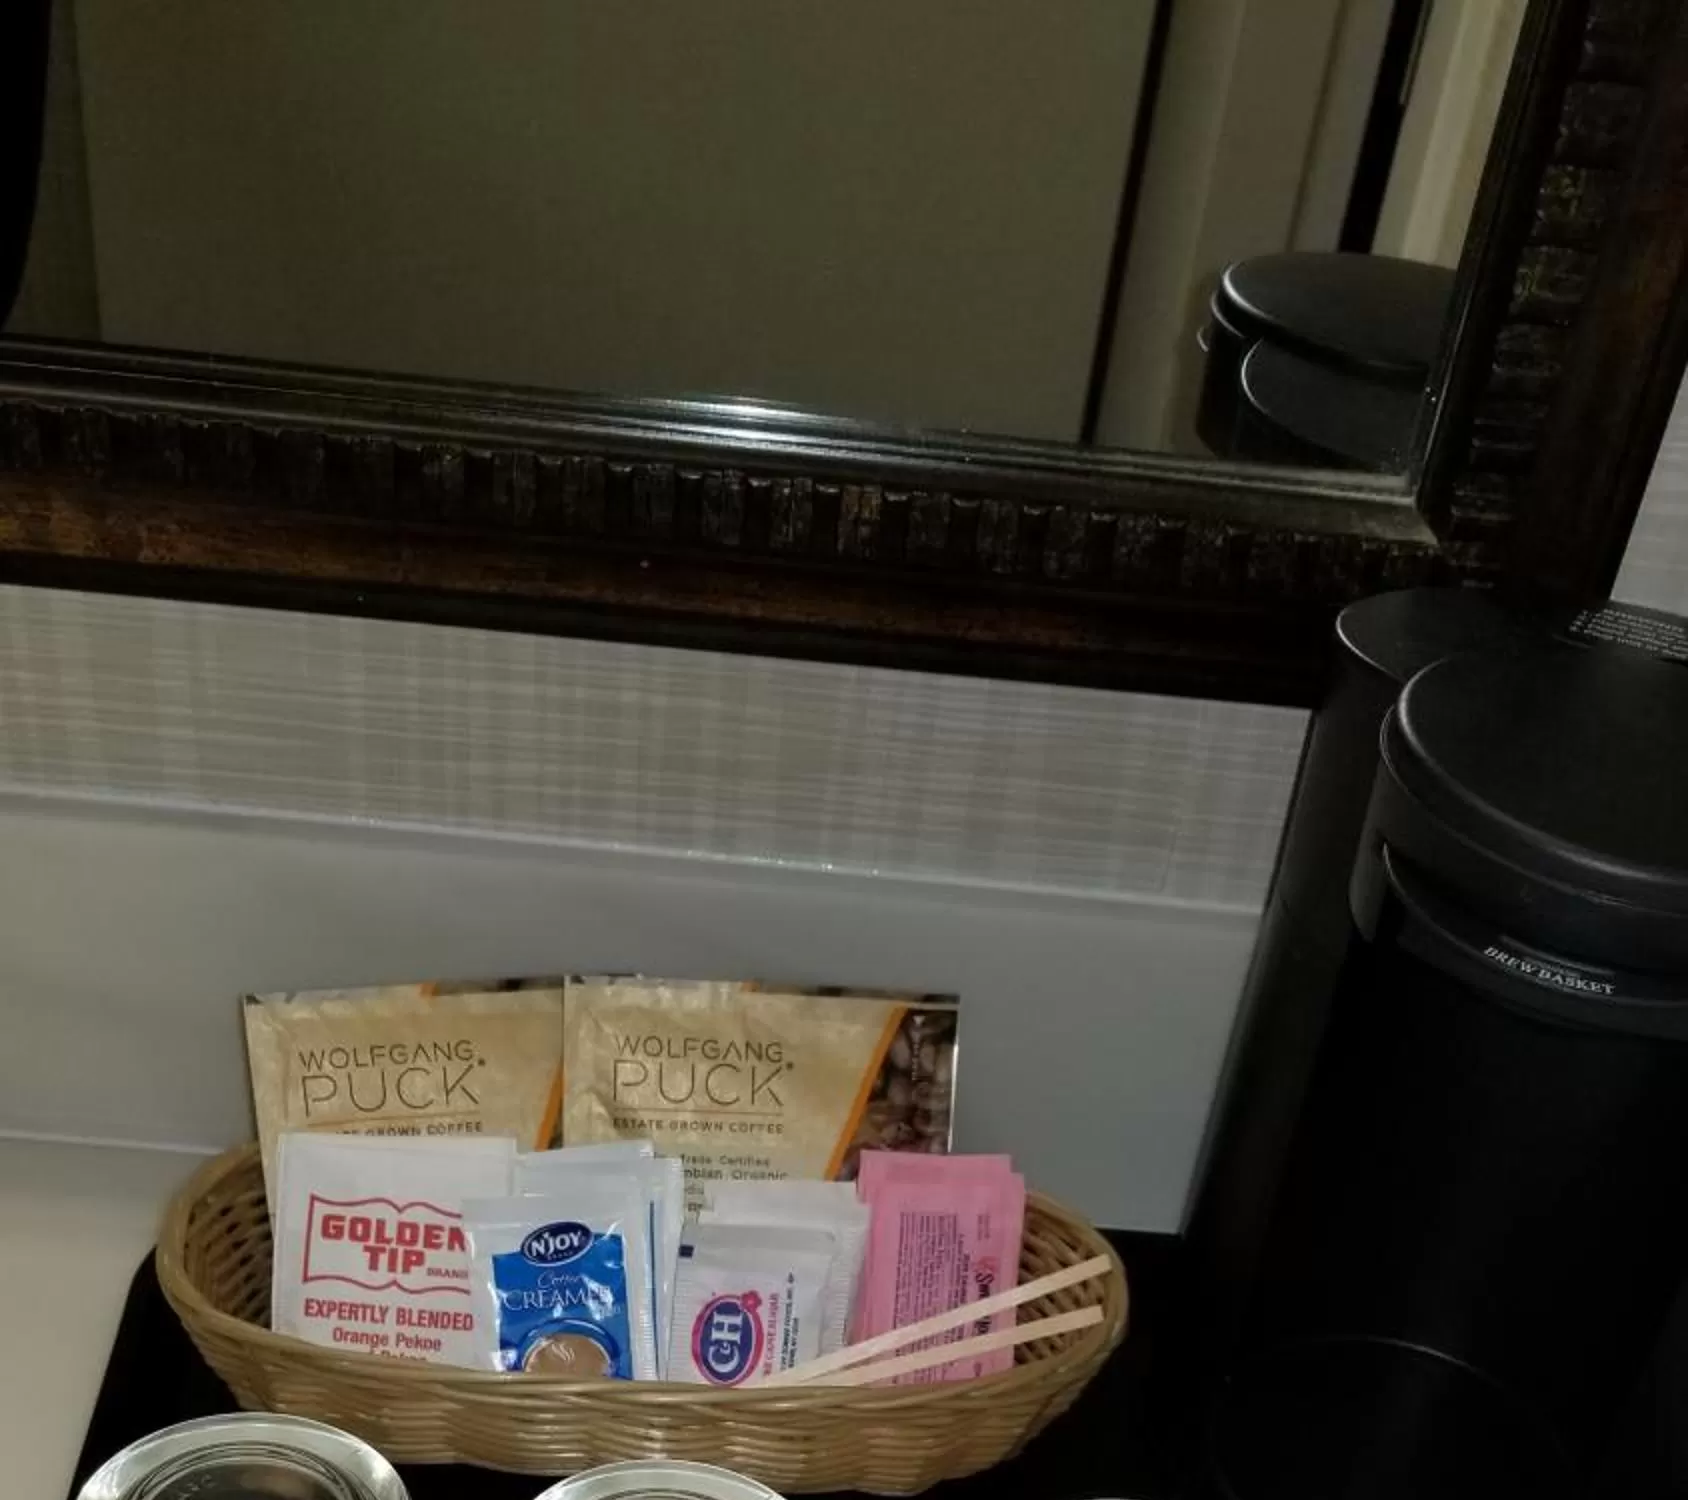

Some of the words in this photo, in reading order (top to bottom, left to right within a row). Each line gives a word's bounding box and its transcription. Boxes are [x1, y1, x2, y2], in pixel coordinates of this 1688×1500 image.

[1483, 945, 1536, 975] BREW
[1538, 969, 1616, 996] BASKET
[298, 1039, 474, 1072] WOLFGANG
[615, 1034, 784, 1064] WOLFGANG
[301, 1064, 481, 1118] PUCK
[612, 1058, 784, 1108] PUCK
[427, 1122, 483, 1136] COFFEE
[612, 1118, 664, 1131] ESTATE
[669, 1120, 724, 1133] GROWN
[728, 1122, 785, 1135] COFFEE
[363, 1245, 425, 1275] TIP
[304, 1298, 389, 1325] EXPERTLY
[396, 1306, 474, 1331] BLENDED
[332, 1326, 389, 1348] Orange
[396, 1331, 442, 1352] Pekoe
